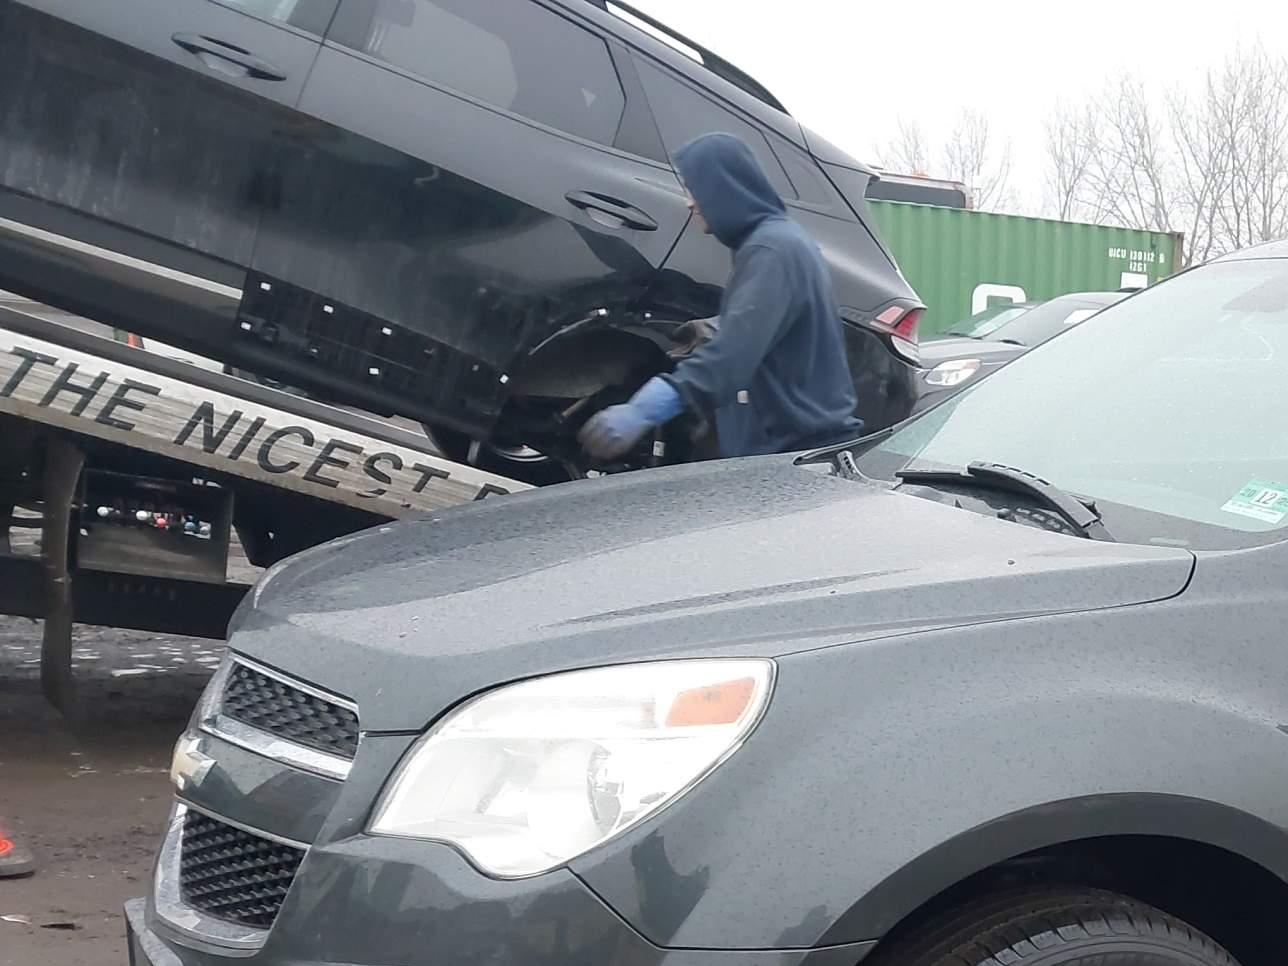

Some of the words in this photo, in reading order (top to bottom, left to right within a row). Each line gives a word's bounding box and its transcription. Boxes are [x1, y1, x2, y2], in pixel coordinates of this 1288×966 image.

[1, 346, 161, 431] THE
[173, 400, 449, 508] NICEST
[1255, 491, 1278, 505] 12
